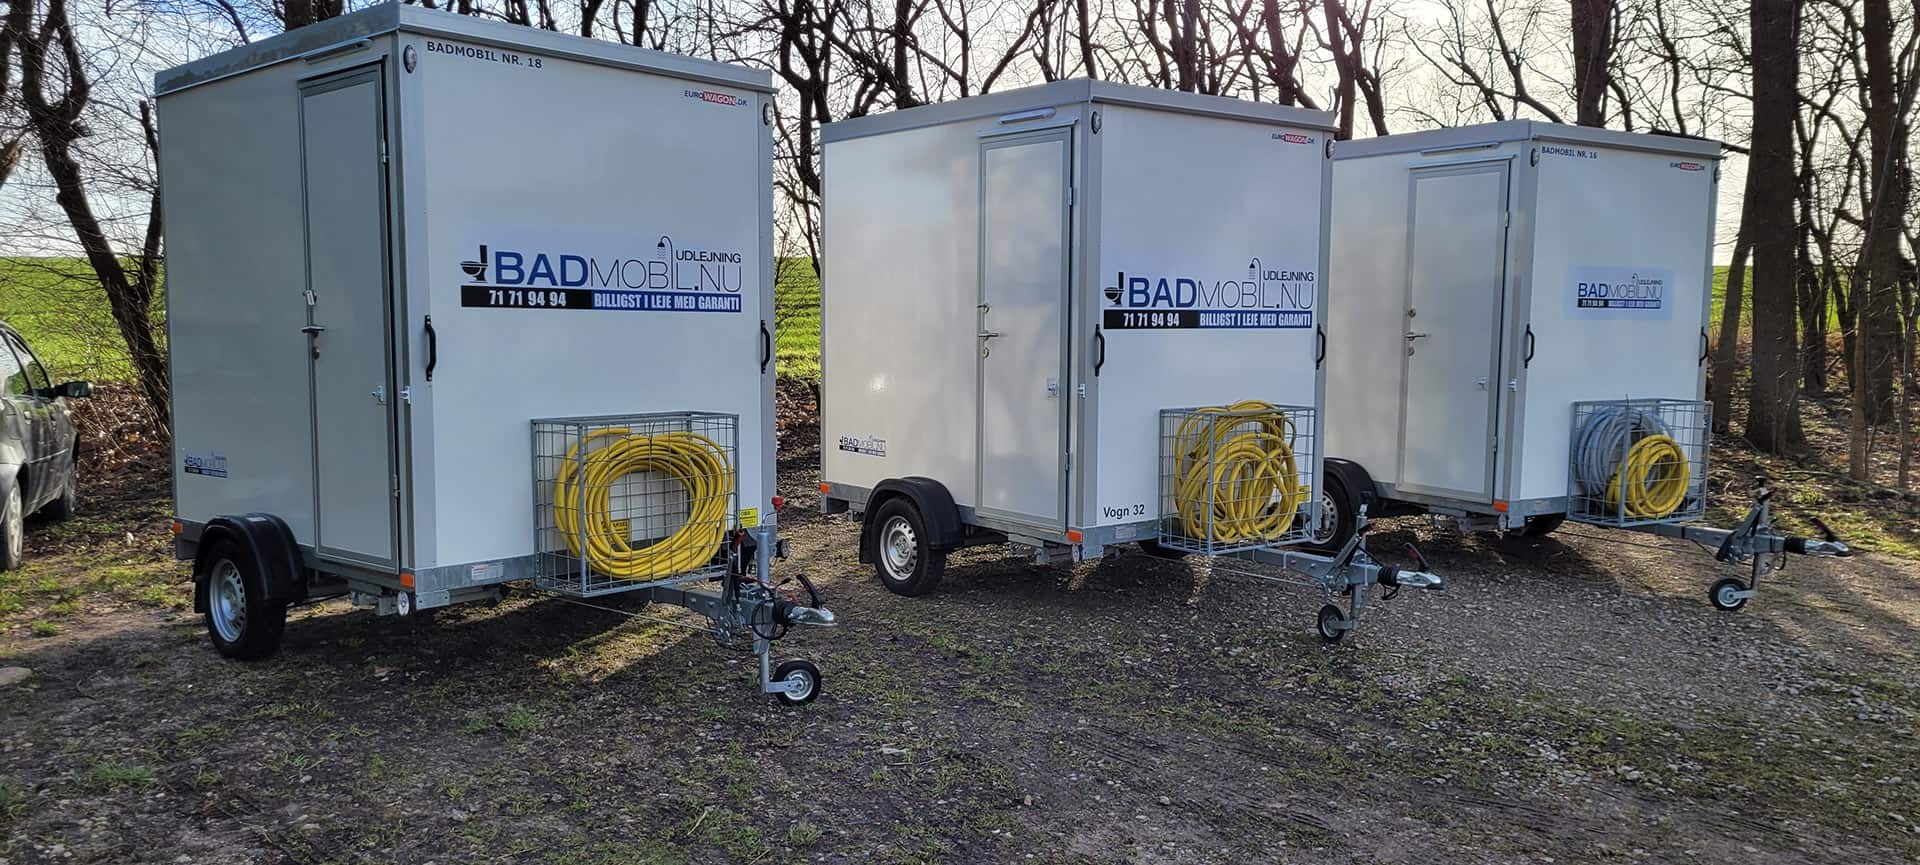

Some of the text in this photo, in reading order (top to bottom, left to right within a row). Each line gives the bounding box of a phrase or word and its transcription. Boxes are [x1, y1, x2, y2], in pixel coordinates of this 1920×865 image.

[427, 41, 543, 69] BADMOBIL NR. 18
[676, 250, 741, 263] UDLEJNING
[1263, 270, 1314, 282] UDLEJNING
[489, 290, 567, 307] 71 71 94 94
[594, 294, 740, 311] BILLIGST I LEJE MED GARANTI
[1123, 313, 1180, 327] 71 71 94 94
[1200, 313, 1236, 327] BILLIGST
[1243, 313, 1258, 327] LEJE
[1260, 313, 1277, 326] MED
[1278, 313, 1310, 326] GARANTI
[1104, 504, 1145, 520] Vogn 32
